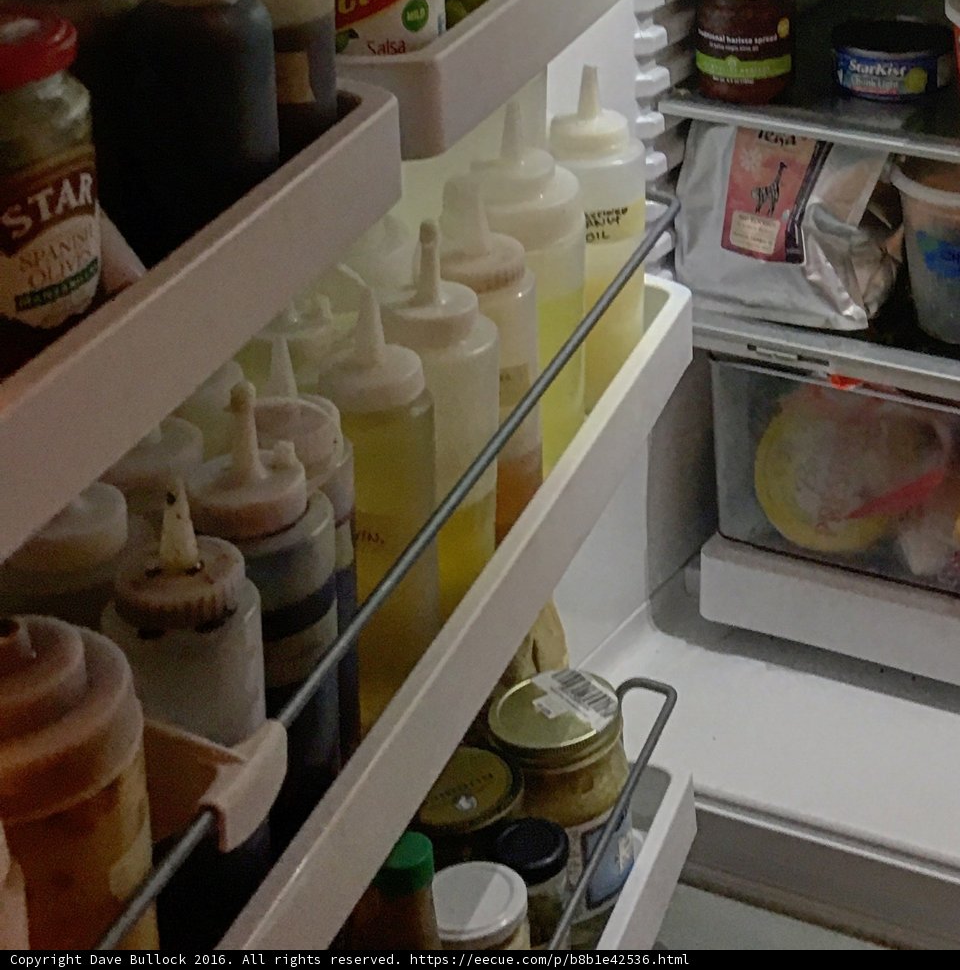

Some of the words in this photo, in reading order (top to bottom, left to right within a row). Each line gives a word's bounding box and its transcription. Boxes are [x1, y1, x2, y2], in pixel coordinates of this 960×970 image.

[367, 38, 407, 56] Salsa
[848, 59, 907, 77] StarKist
[1, 172, 93, 239] STAR
